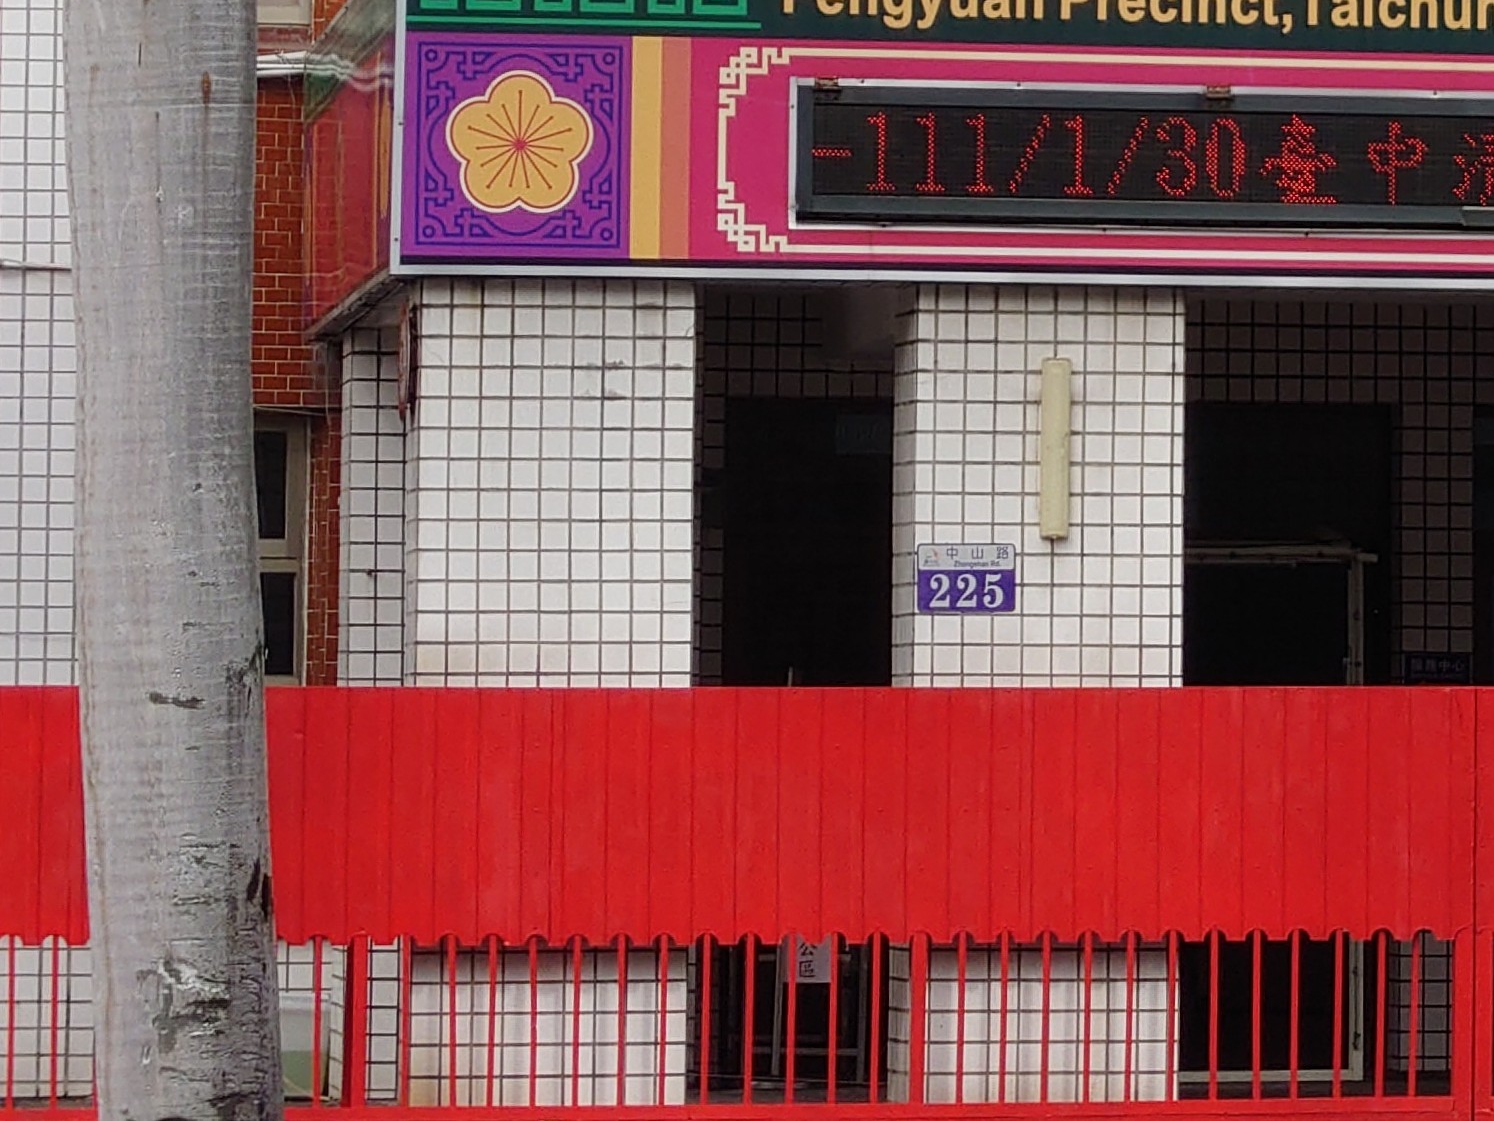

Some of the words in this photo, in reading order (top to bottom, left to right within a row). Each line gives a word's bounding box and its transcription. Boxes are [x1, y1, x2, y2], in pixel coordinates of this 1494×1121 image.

[946, 546, 1009, 559] 中山路
[929, 573, 1004, 608] 225
